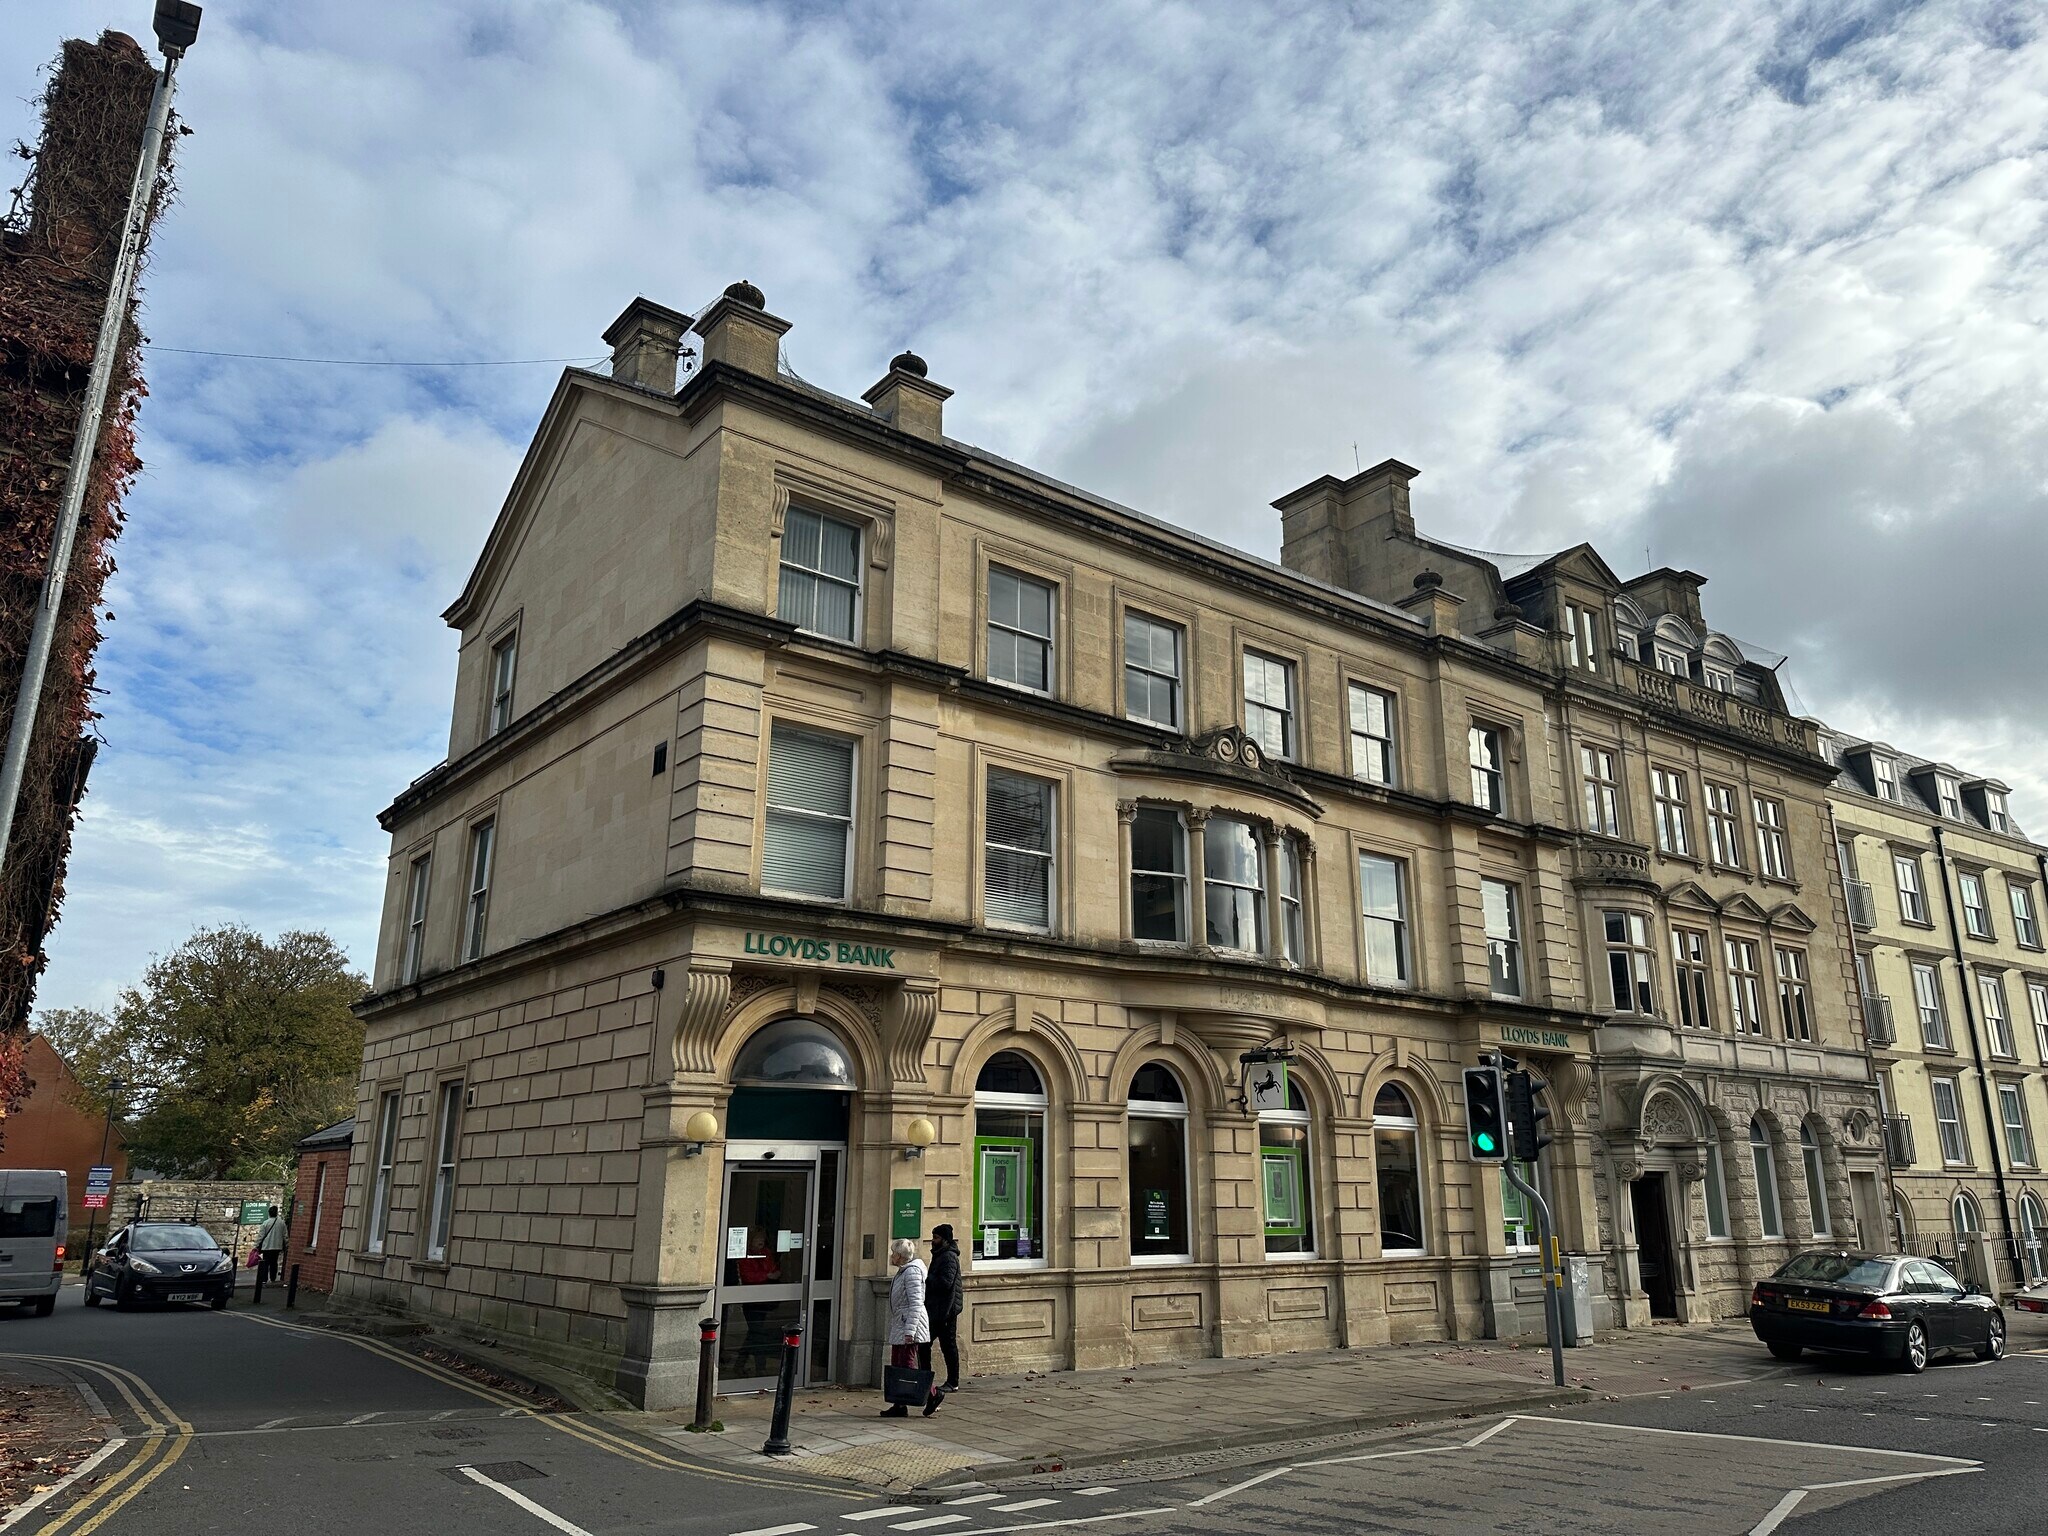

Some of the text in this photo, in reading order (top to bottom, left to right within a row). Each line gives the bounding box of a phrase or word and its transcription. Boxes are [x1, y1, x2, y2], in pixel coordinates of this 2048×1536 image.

[745, 932, 896, 969] LLOYDS BANK
[1501, 1026, 1570, 1048] LLOYDS BANK
[992, 1157, 1009, 1165] Horse
[991, 1195, 1010, 1203] Power
[1790, 1300, 1826, 1311] EK53 ZZF
